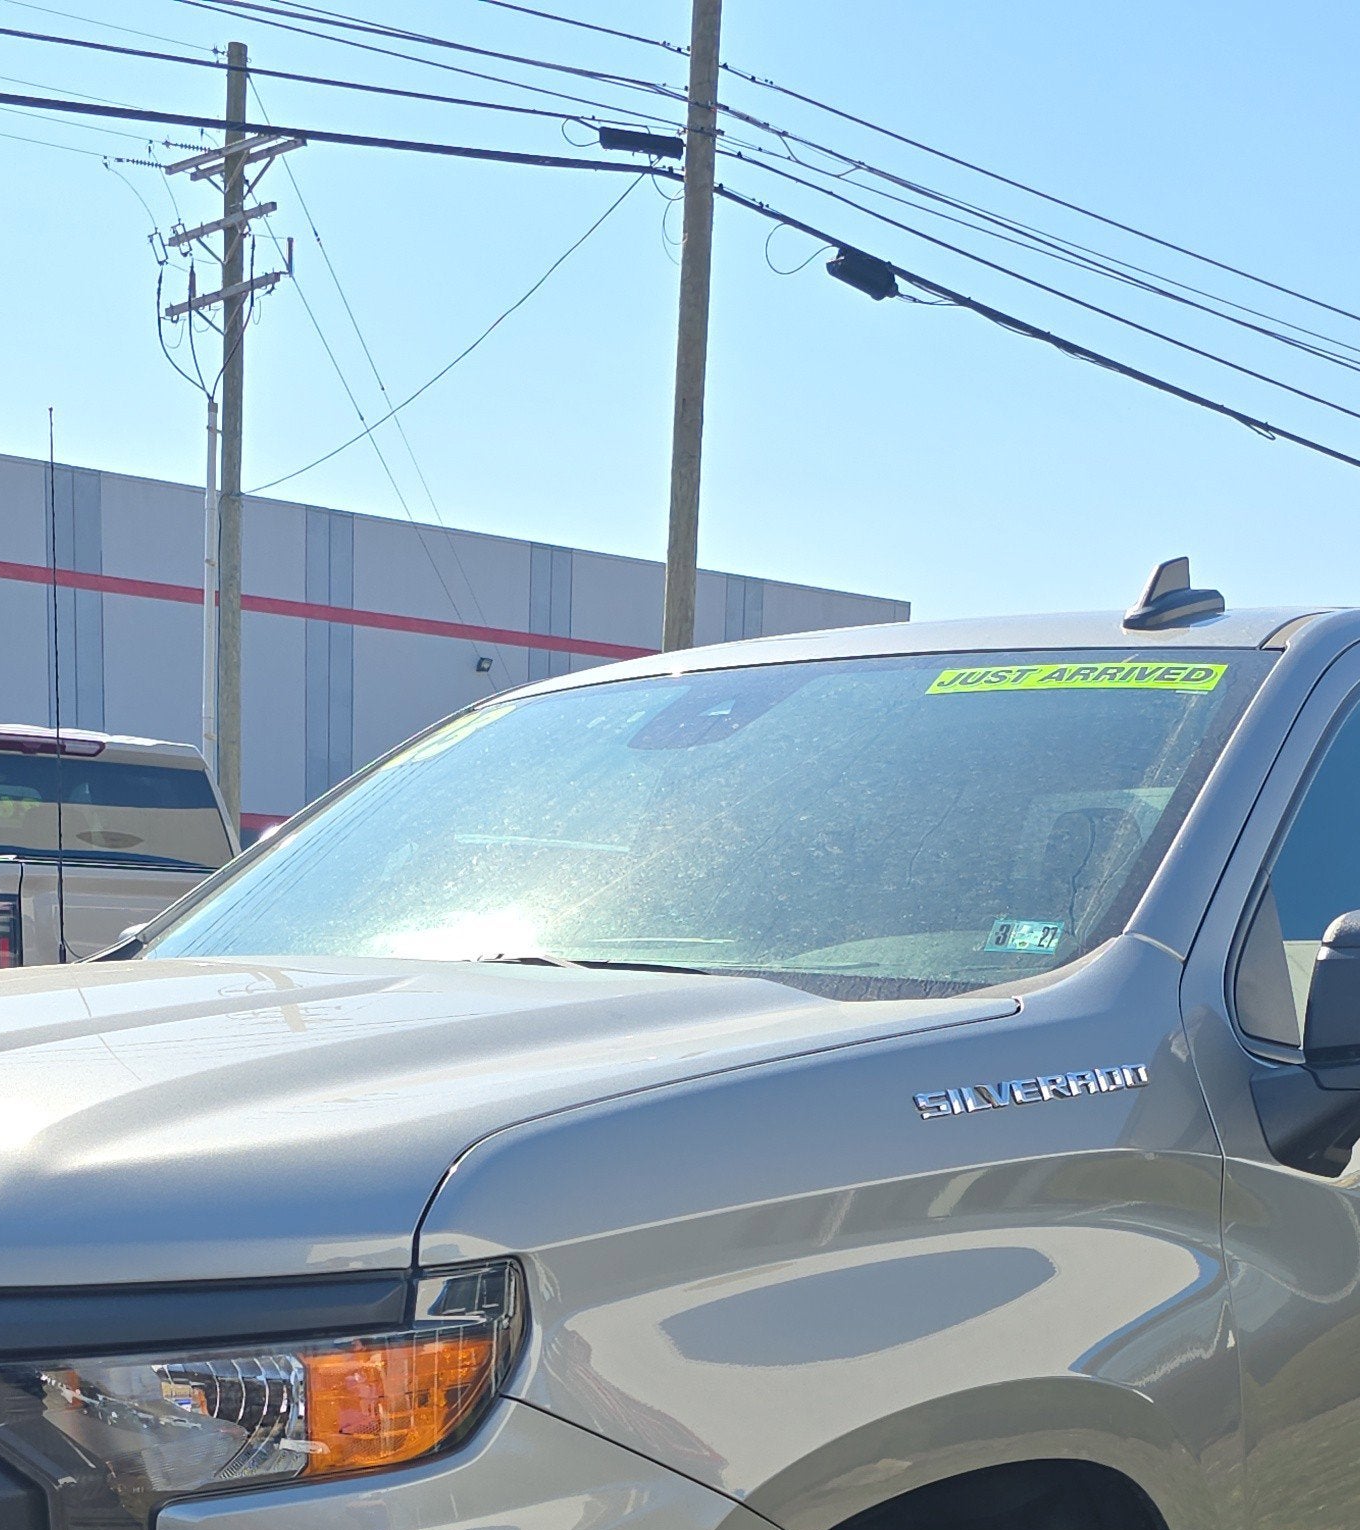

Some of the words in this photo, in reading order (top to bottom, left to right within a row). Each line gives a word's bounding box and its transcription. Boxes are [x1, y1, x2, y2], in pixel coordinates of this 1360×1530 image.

[936, 667, 1040, 688] JUST
[1037, 665, 1220, 684] ARRIVED
[995, 923, 1011, 947] 3
[1037, 926, 1059, 949] 27
[913, 1063, 1150, 1120] SILVERADO
